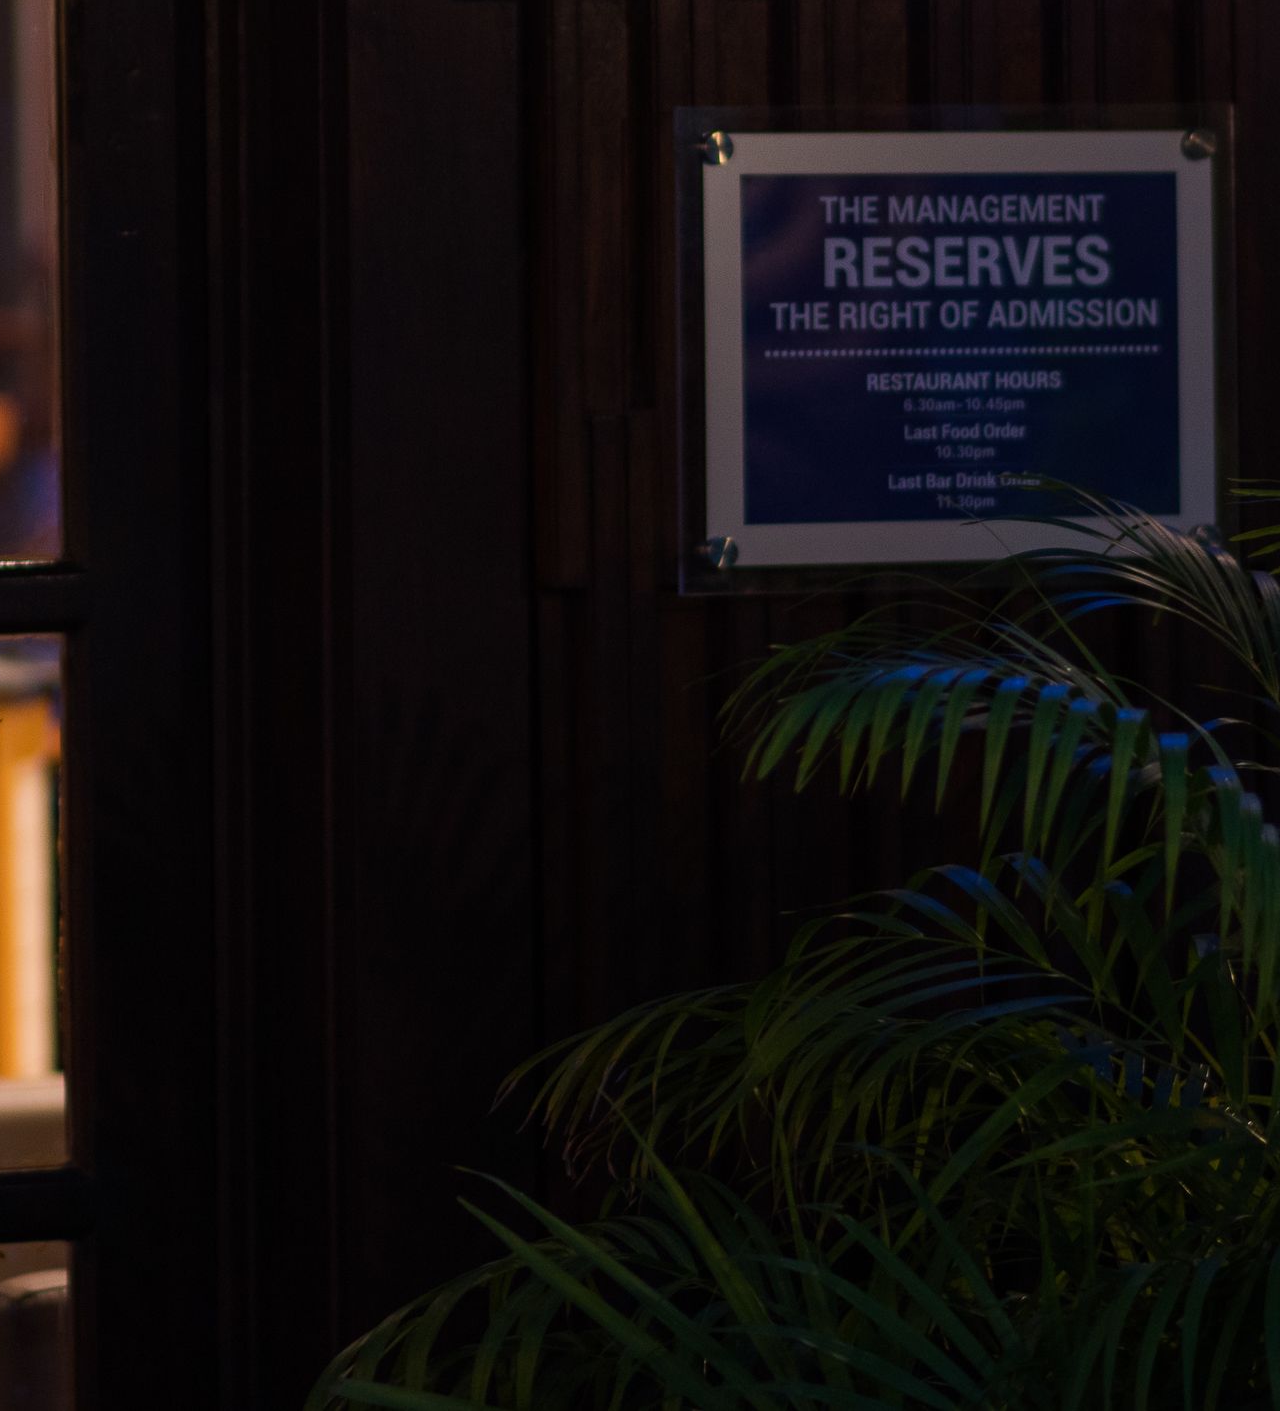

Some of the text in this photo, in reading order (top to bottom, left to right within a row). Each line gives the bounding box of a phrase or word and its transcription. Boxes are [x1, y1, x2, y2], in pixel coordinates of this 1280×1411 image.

[821, 194, 1104, 224] THE MANAGEMENT
[824, 236, 1111, 288] RESERVES
[770, 299, 1158, 331] THE RIGHT OF ADMISSION
[866, 371, 1062, 393] RESTAURANT HOURS
[904, 422, 1026, 440] Last Food Order
[888, 474, 922, 490] Last
[926, 473, 951, 489] Bar
[956, 471, 996, 489] Drink
